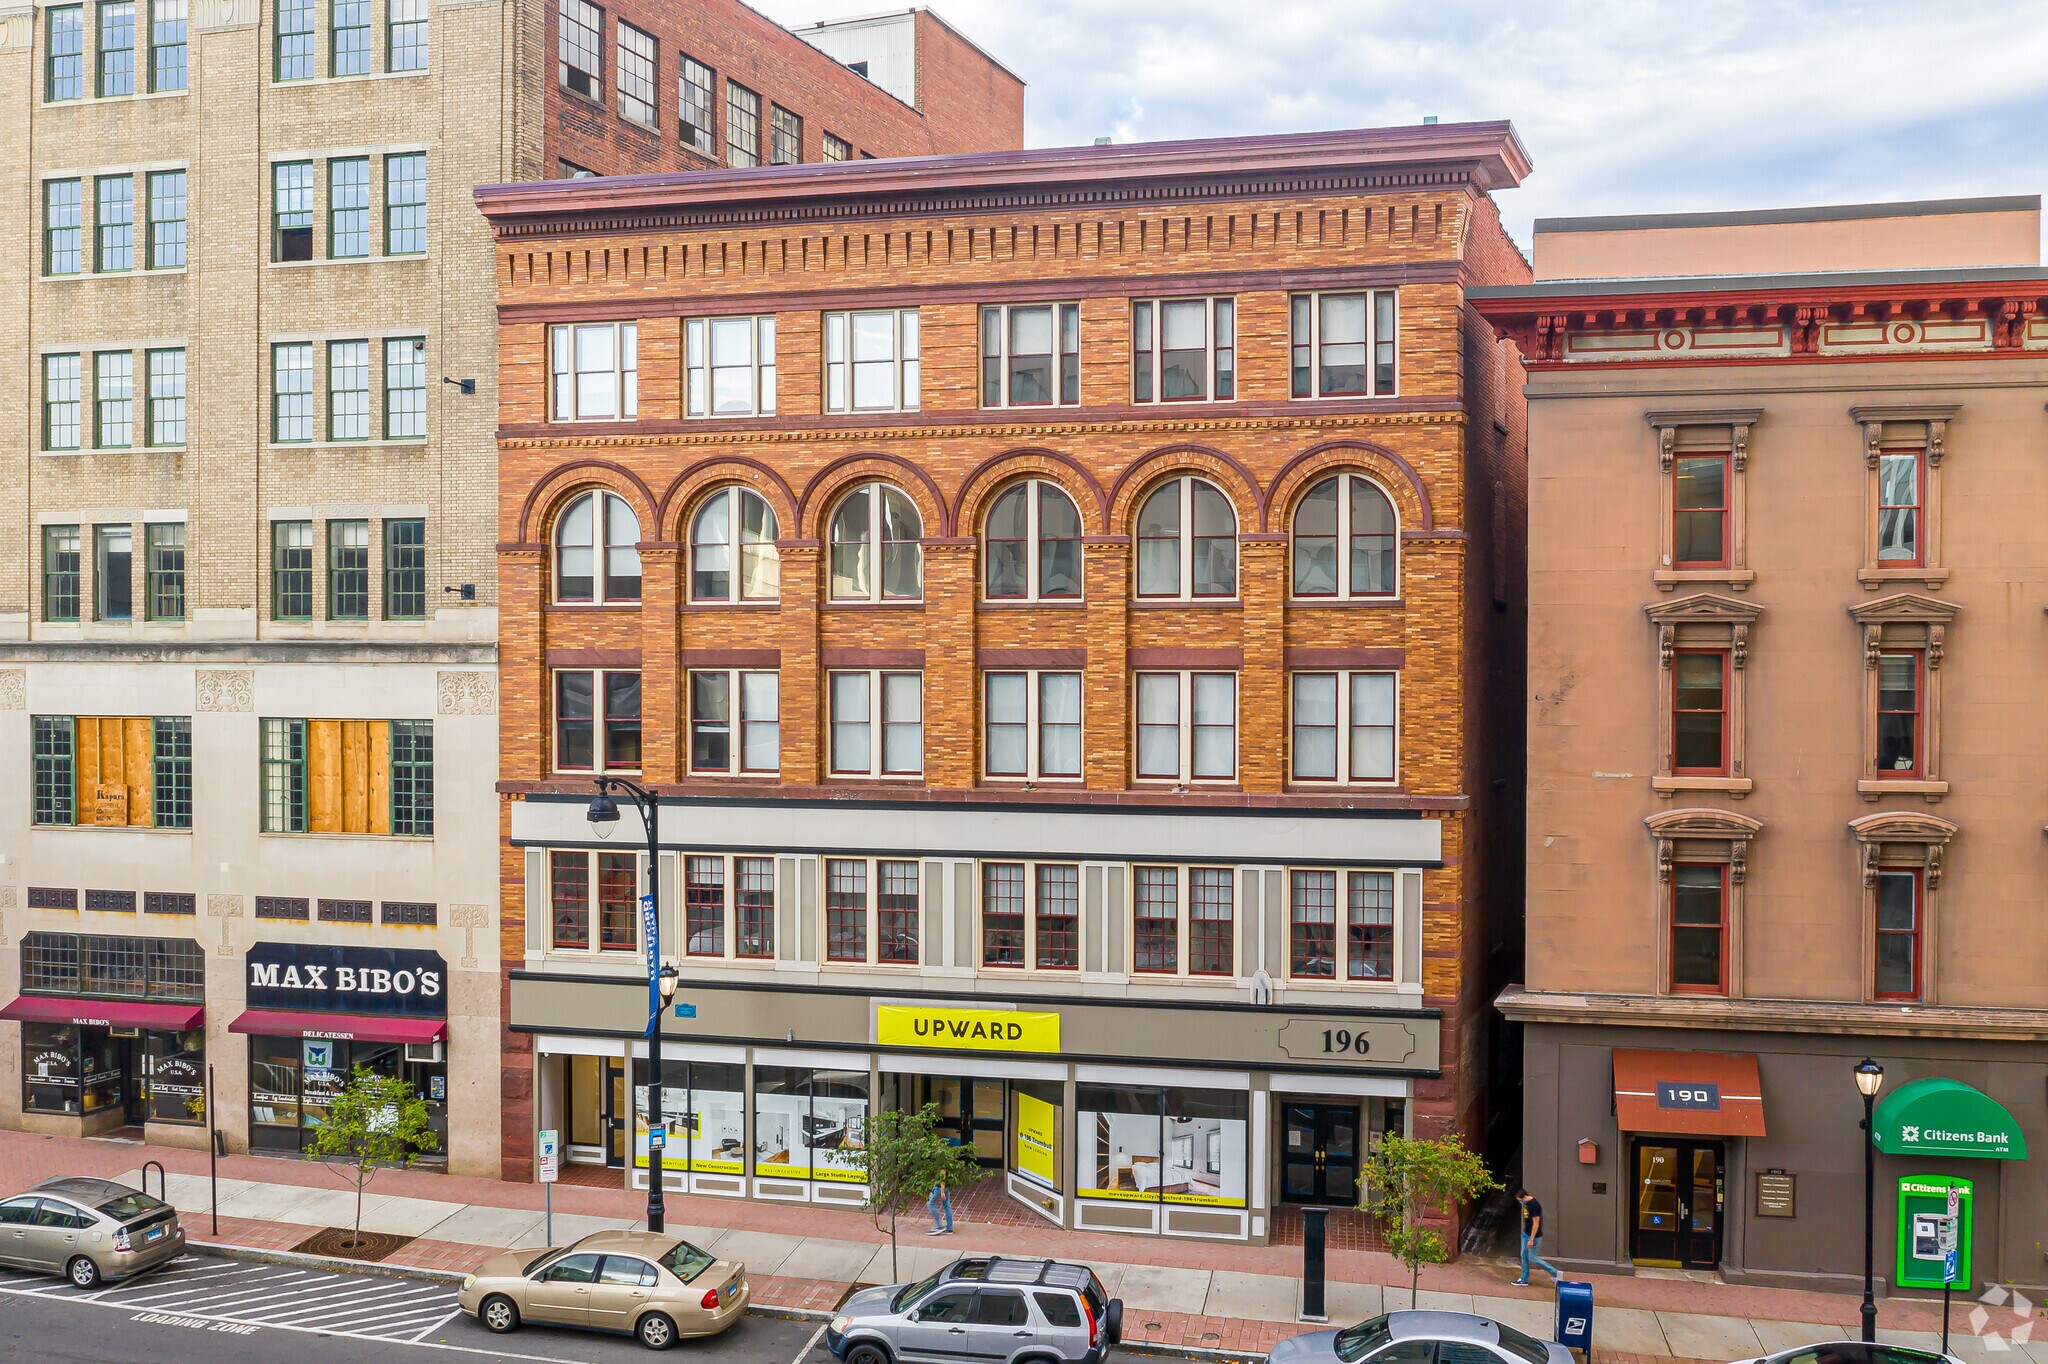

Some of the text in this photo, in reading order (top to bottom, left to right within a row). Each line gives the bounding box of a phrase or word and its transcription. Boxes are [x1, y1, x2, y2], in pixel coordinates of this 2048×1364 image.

[97, 790, 125, 801] Kapura
[250, 963, 440, 996] MAX BIBO'S
[72, 1017, 110, 1026] MAX BIBO'S
[302, 1030, 354, 1040] DELICATESSEN
[914, 1018, 1023, 1041] UPWARD
[1321, 1029, 1370, 1054] 196
[33, 1051, 72, 1068] MAX BIBO'S
[156, 1060, 197, 1076] MAX BIBO'S
[304, 1071, 346, 1088] MAX BIBO'S
[1668, 1089, 1708, 1102] 190
[1032, 1136, 1052, 1150] Trumbull
[1923, 1129, 2009, 1144] Citizens Bank
[708, 1163, 740, 1171] Construction
[1652, 1156, 1665, 1164] 190
[1911, 1183, 1970, 1195] Citizens nk
[129, 1312, 262, 1335] LOADING ZONE
